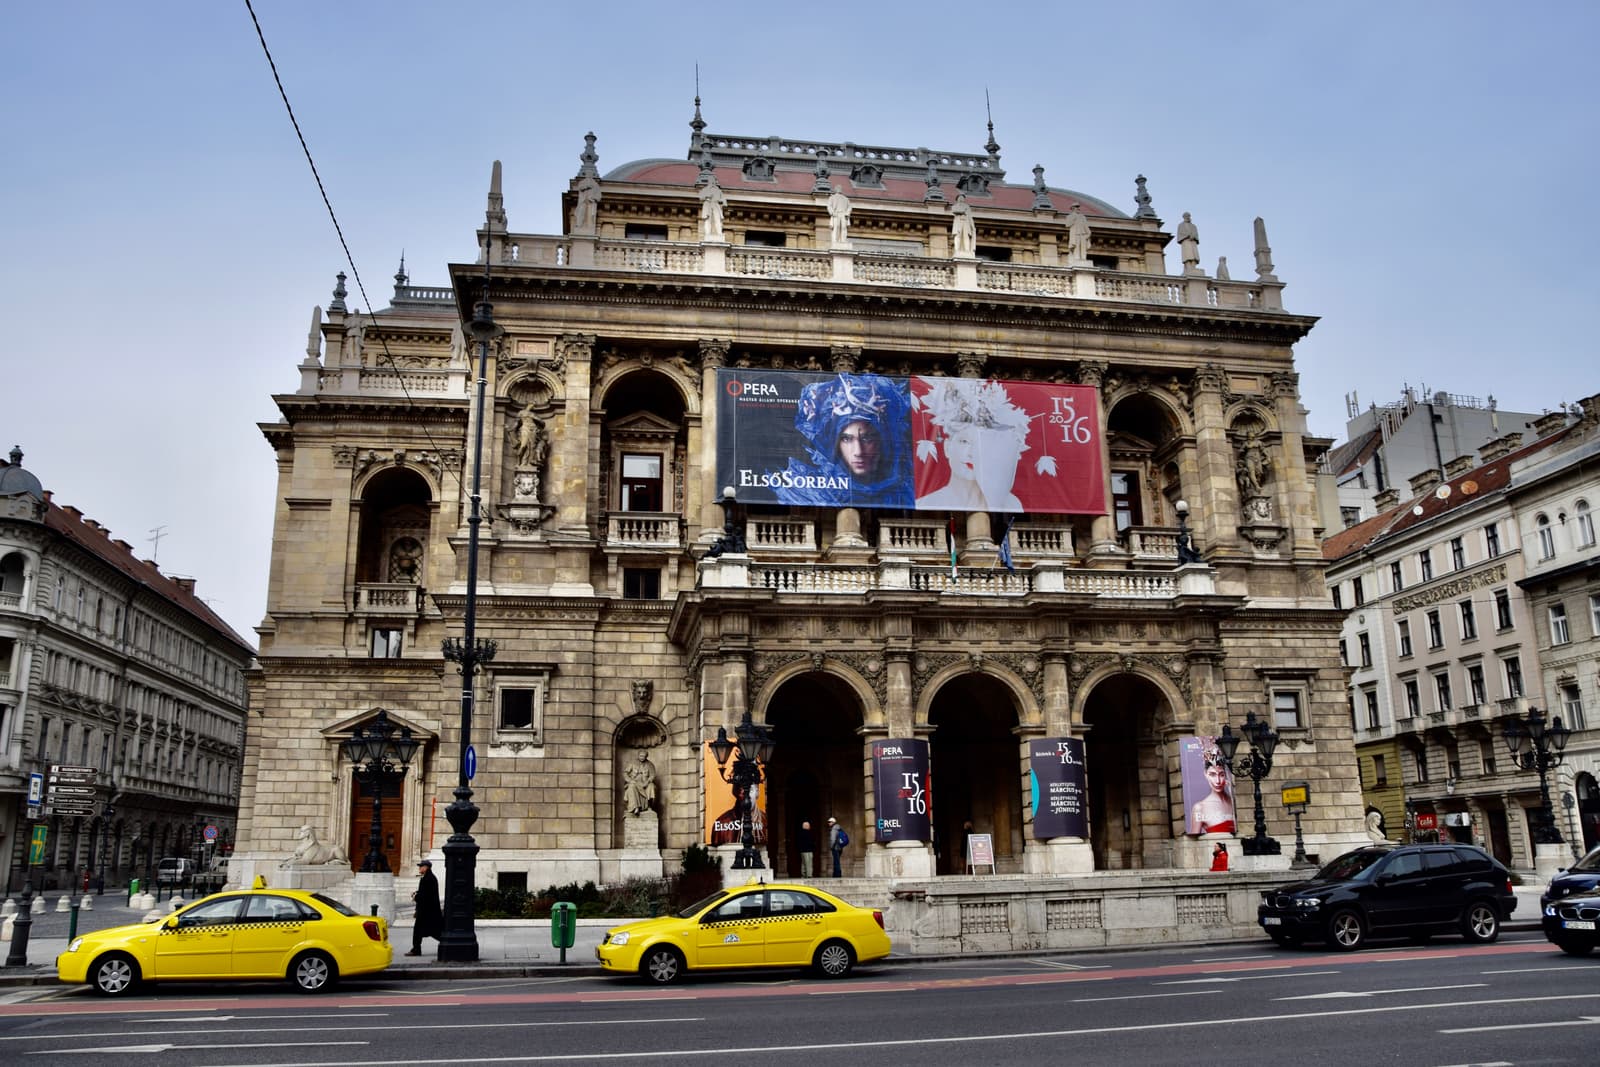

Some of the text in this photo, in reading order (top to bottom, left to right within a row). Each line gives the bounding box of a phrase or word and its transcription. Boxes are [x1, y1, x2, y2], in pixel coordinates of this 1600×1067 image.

[726, 380, 779, 396] OPERA
[1050, 396, 1076, 424] 15
[1060, 416, 1092, 444] 16
[873, 745, 903, 758] OPERA
[901, 771, 920, 797] 15
[907, 789, 926, 815] 16
